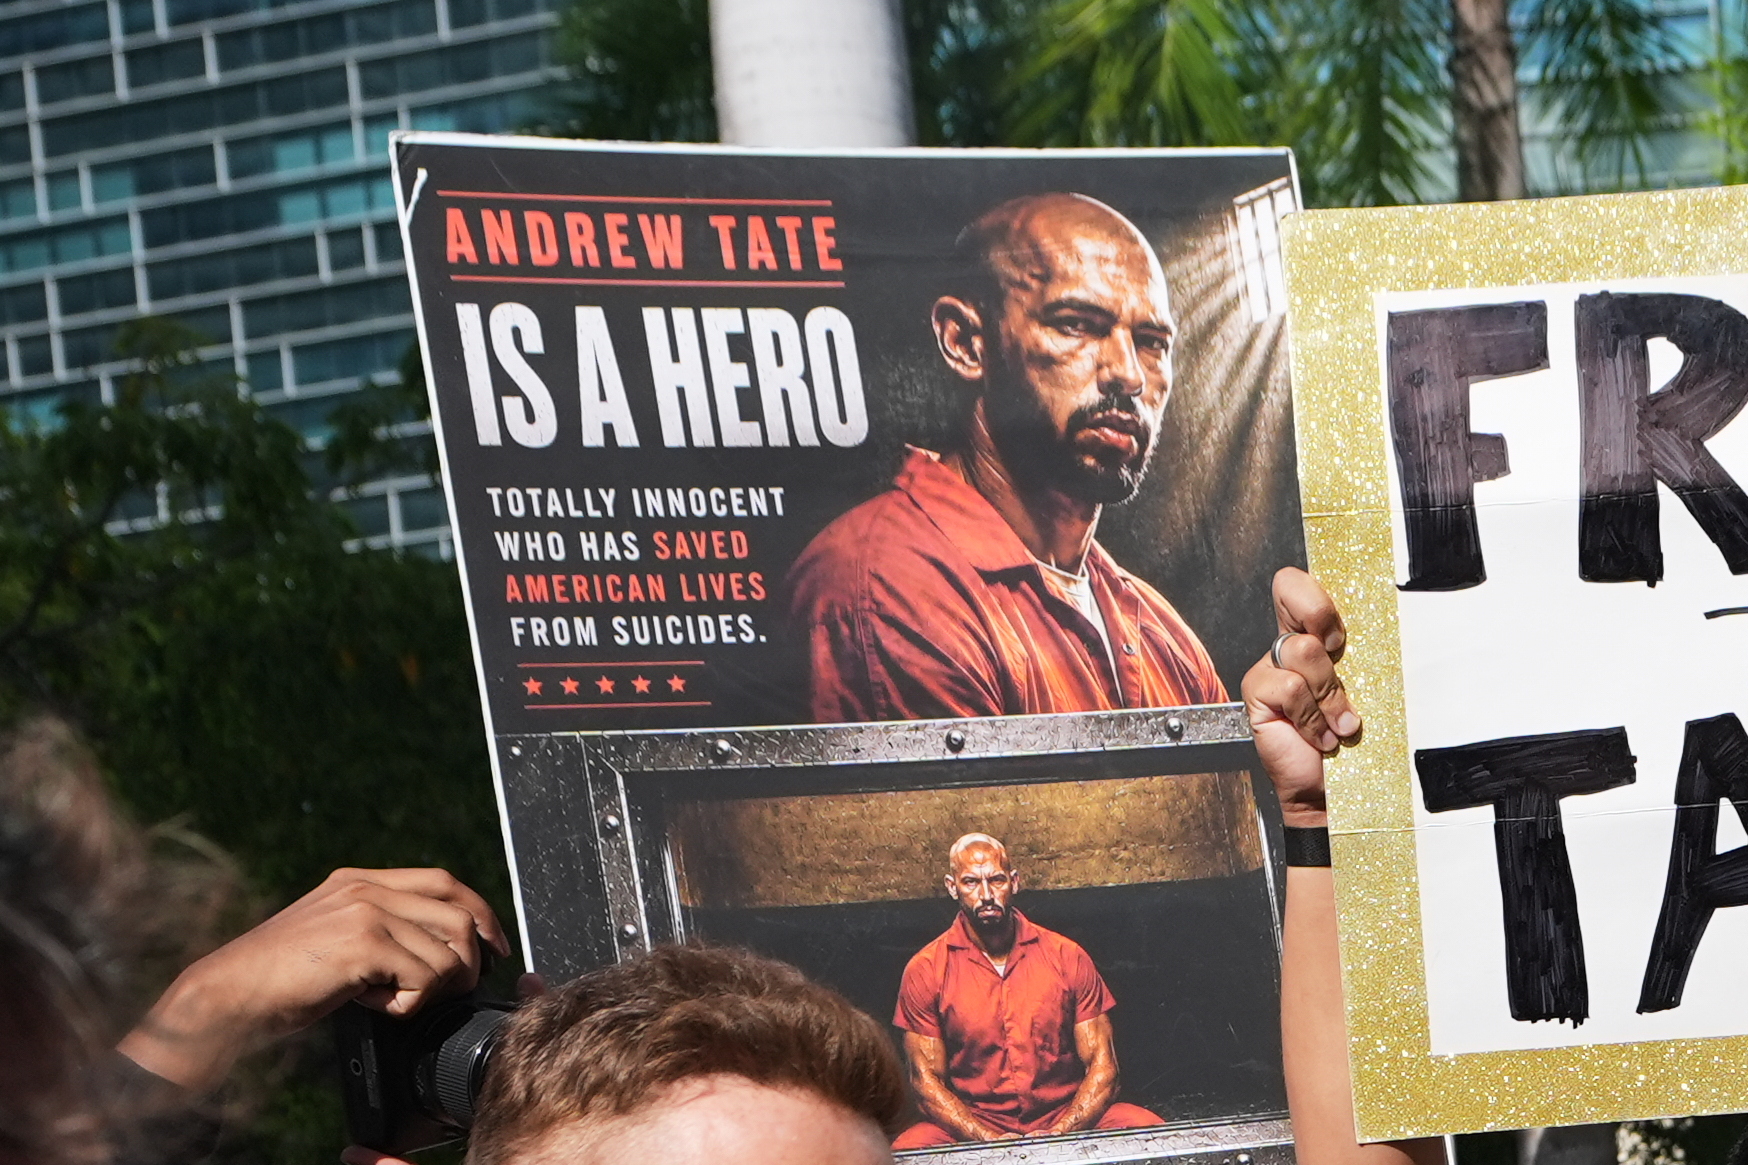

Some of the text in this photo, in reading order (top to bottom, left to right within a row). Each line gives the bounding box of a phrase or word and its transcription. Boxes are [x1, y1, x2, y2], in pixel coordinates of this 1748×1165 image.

[446, 207, 843, 271] ANDREW TATE
[455, 301, 869, 449] IS A HERO
[486, 486, 785, 518] TOTALLY INNOCENT
[495, 530, 749, 561] WHO HAS SAVED
[505, 571, 767, 603] AMERICAN LIVES
[510, 613, 767, 647] FROM SUICIDES.
